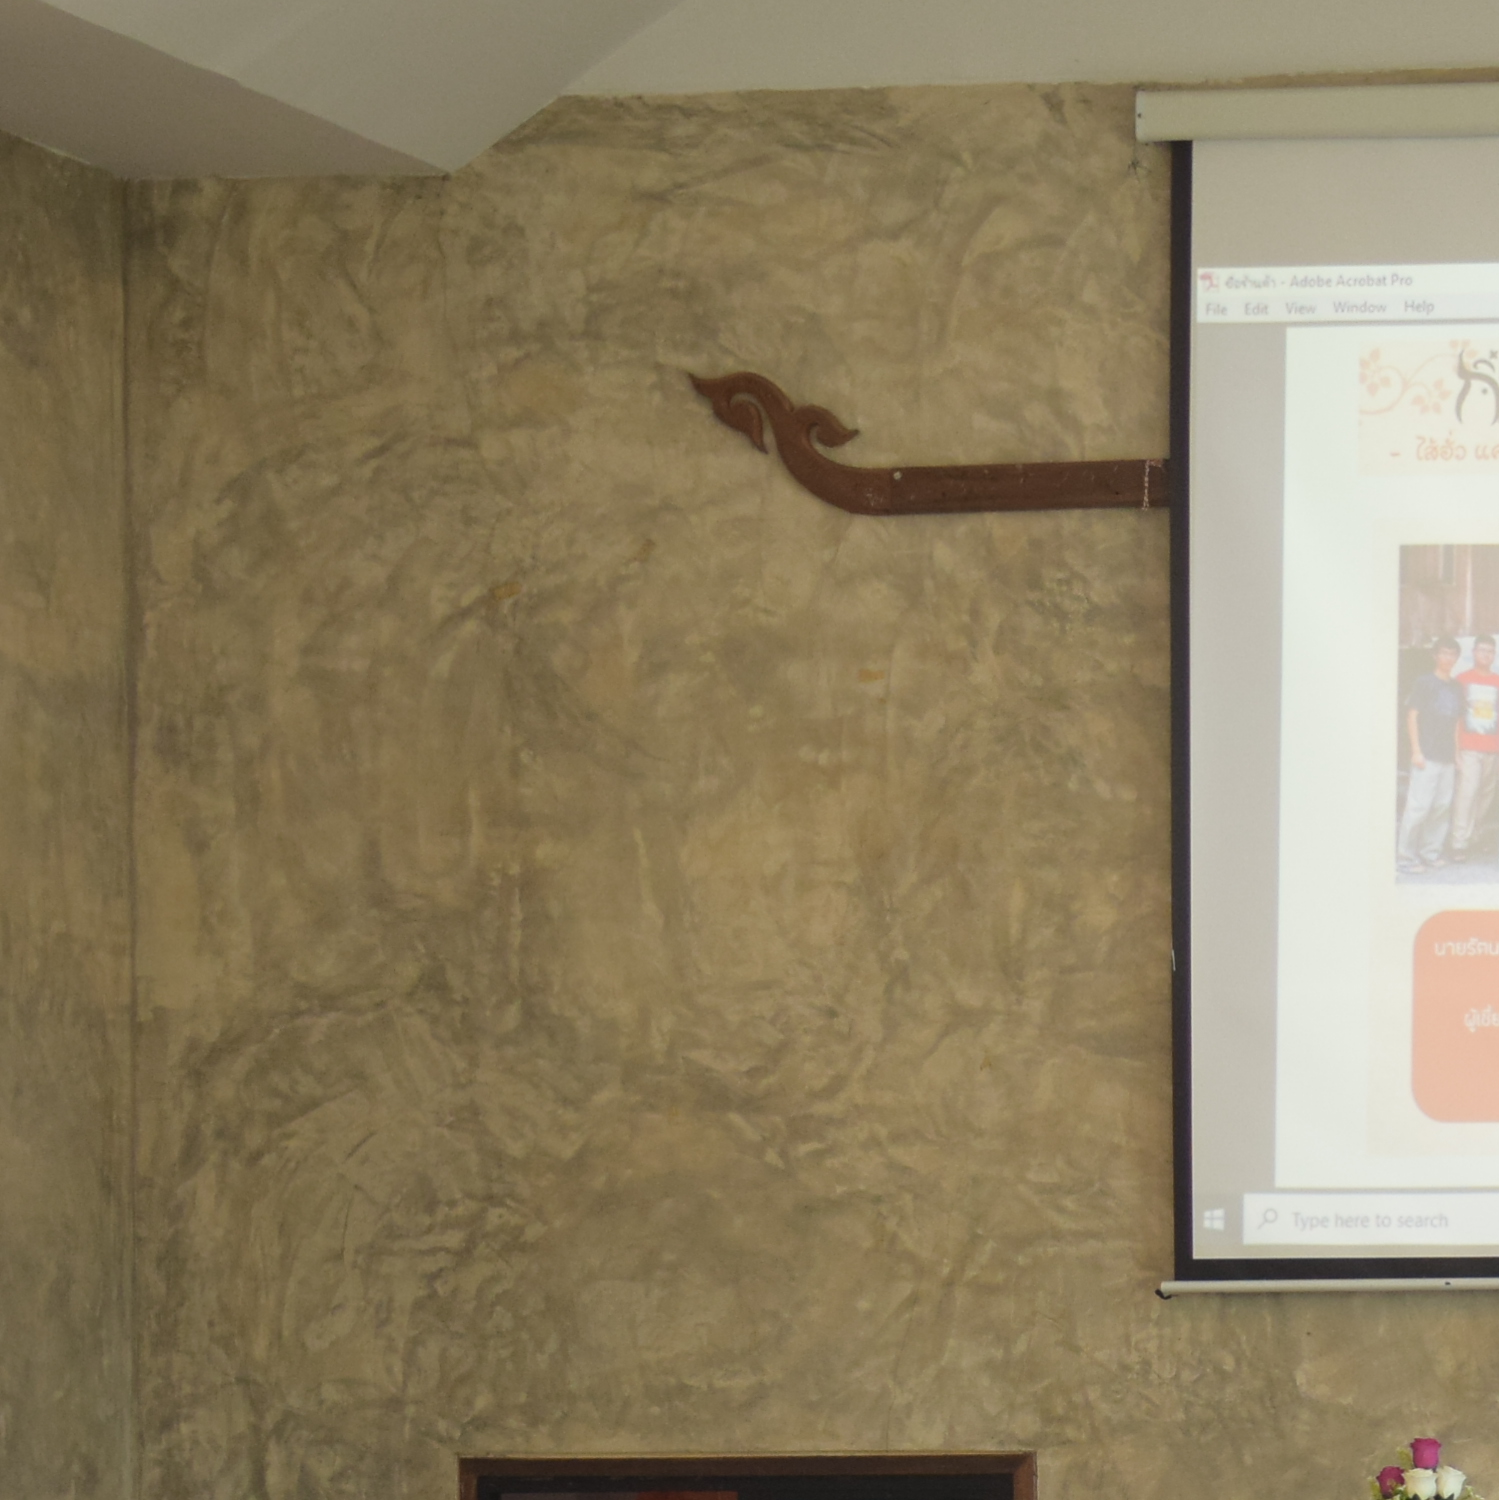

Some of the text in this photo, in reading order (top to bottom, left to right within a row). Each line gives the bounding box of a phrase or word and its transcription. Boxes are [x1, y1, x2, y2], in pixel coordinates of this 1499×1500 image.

[1289, 274, 1333, 288] Adobe
[1335, 273, 1388, 288] Acrobat
[1391, 273, 1414, 287] Pro
[1205, 300, 1436, 316] File Edit View Window Help
[1292, 1210, 1449, 1231] Type here to search
